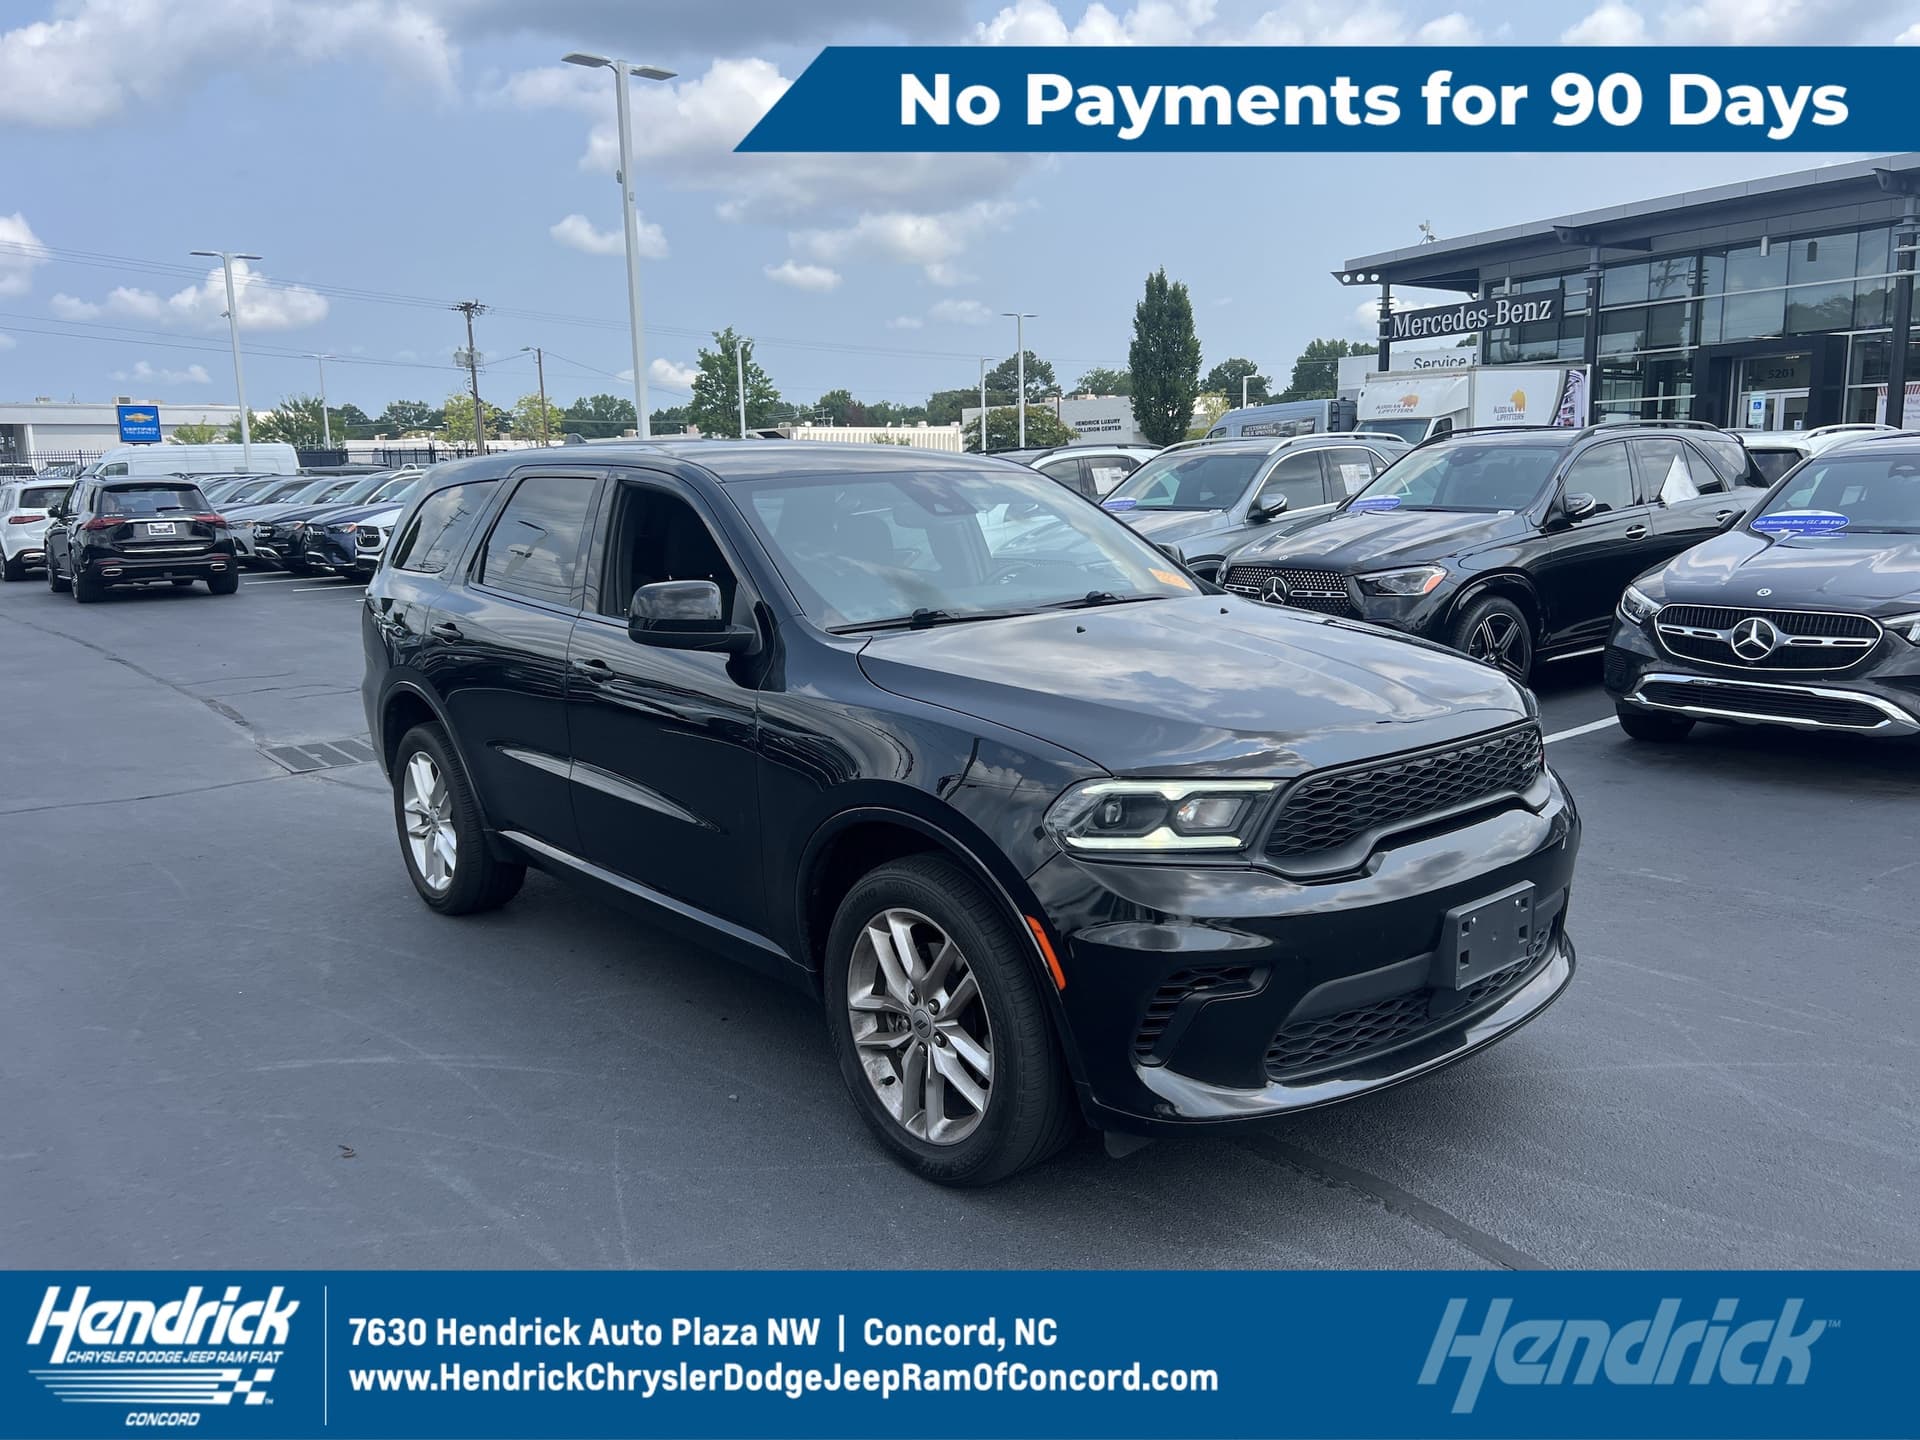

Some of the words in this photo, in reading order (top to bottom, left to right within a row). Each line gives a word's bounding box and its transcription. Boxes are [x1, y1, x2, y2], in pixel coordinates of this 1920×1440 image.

[1392, 299, 1552, 338] Mercedes-Benz
[1413, 355, 1467, 369] Service
[1768, 368, 1794, 379] 5201
